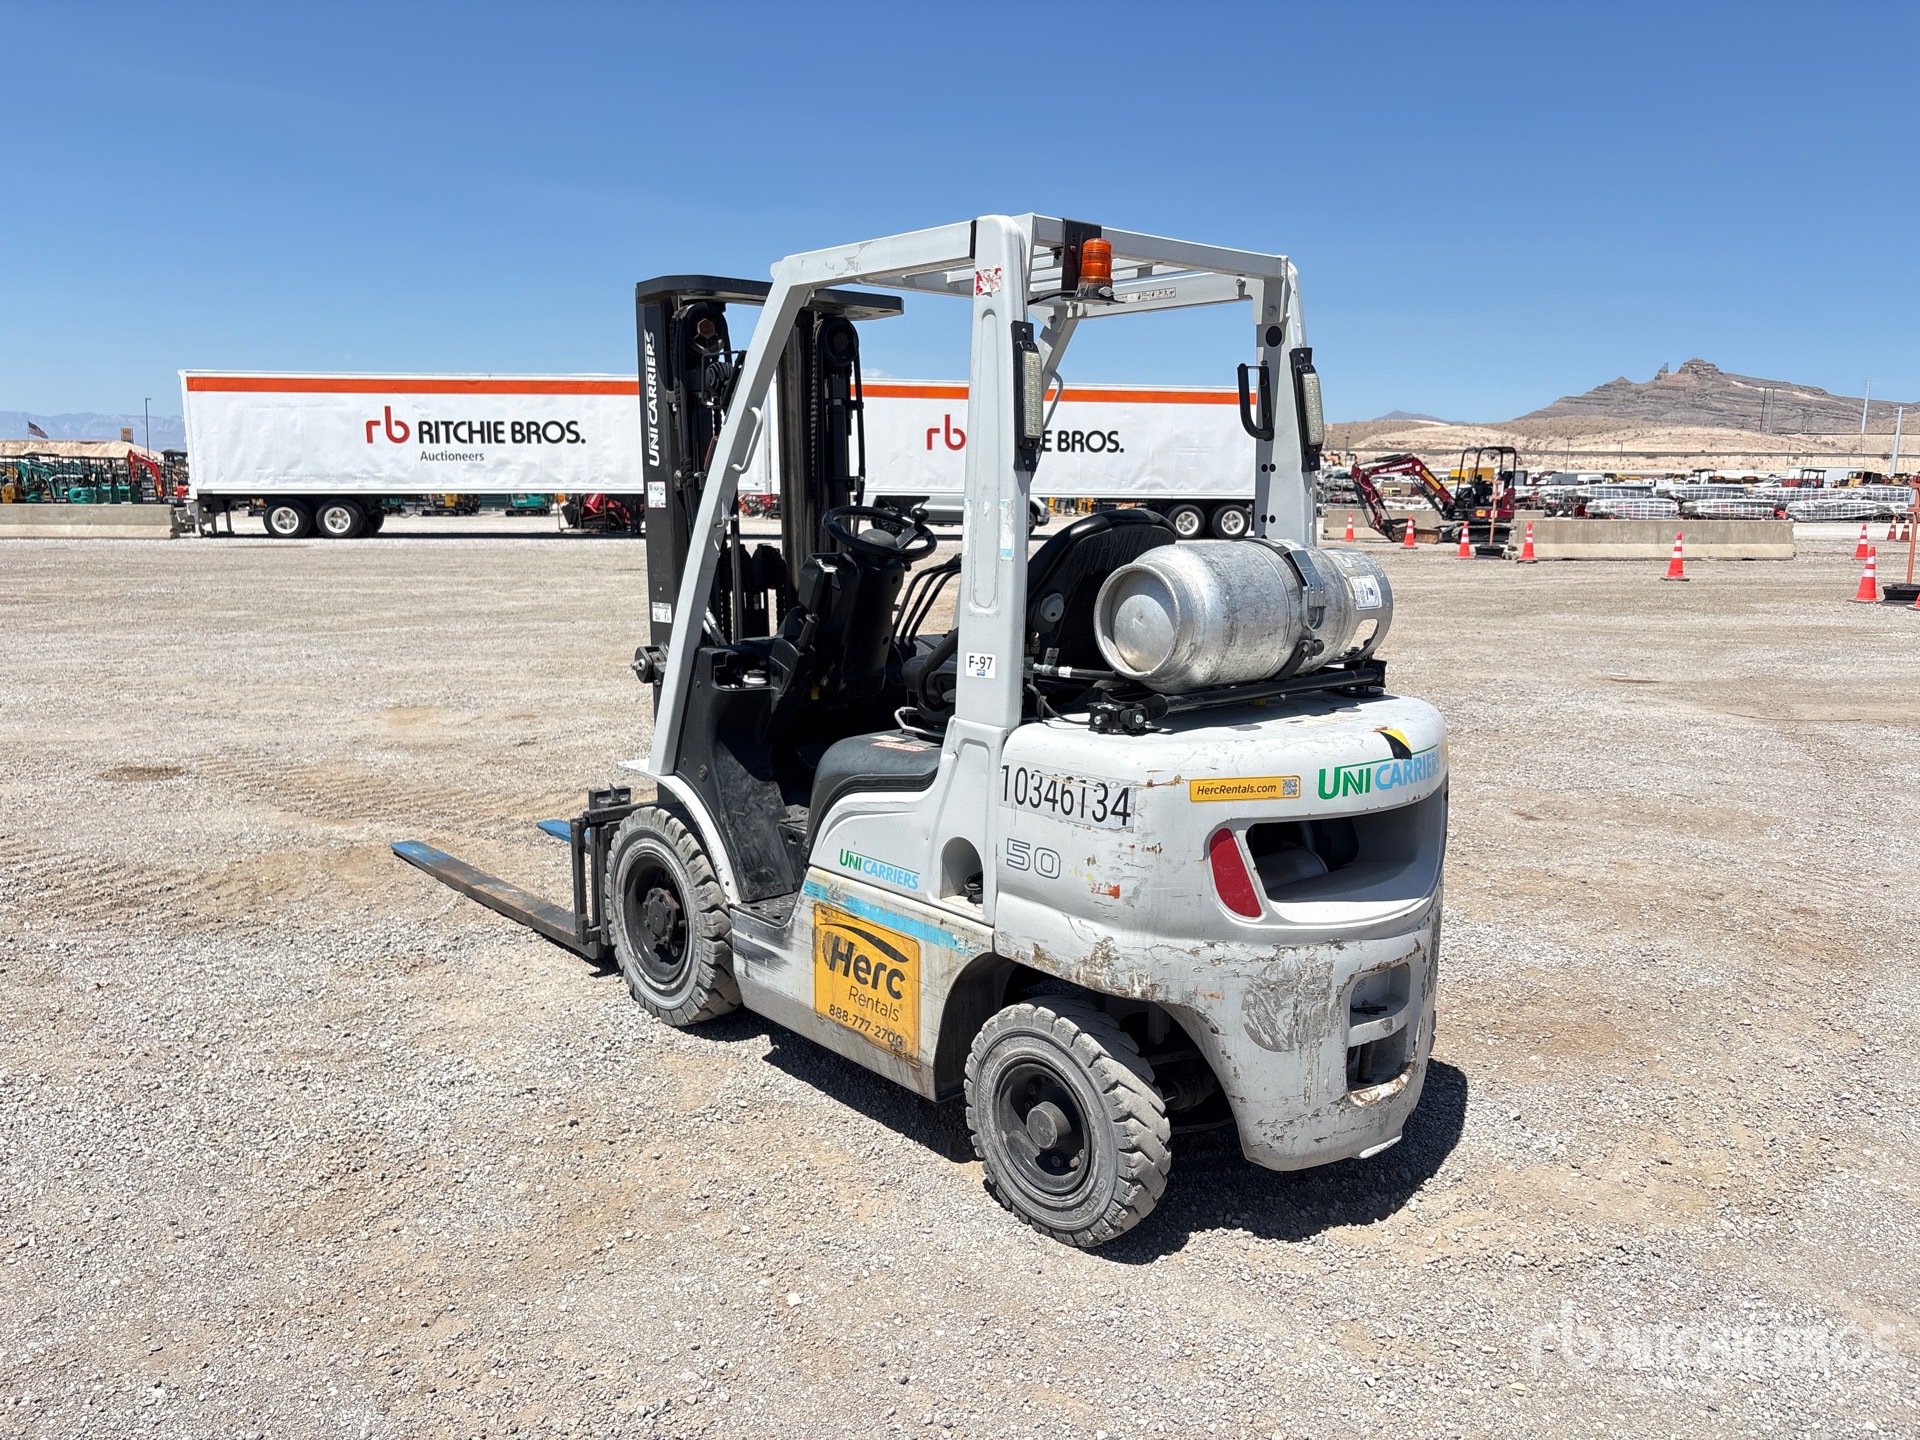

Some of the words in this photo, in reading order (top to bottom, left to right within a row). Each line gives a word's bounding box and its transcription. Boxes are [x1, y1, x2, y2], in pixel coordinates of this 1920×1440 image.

[418, 420, 506, 444] RITCHIE
[511, 420, 587, 444] BROS.
[1057, 430, 1125, 453] BROS.
[420, 450, 485, 462] Auctioneers
[968, 655, 994, 670] F-97
[1001, 764, 1132, 827] 10346134
[1196, 783, 1278, 796] HercRentals.com
[1006, 837, 1061, 880] 50
[829, 935, 906, 1000] Herc
[848, 985, 900, 1022] Rentals
